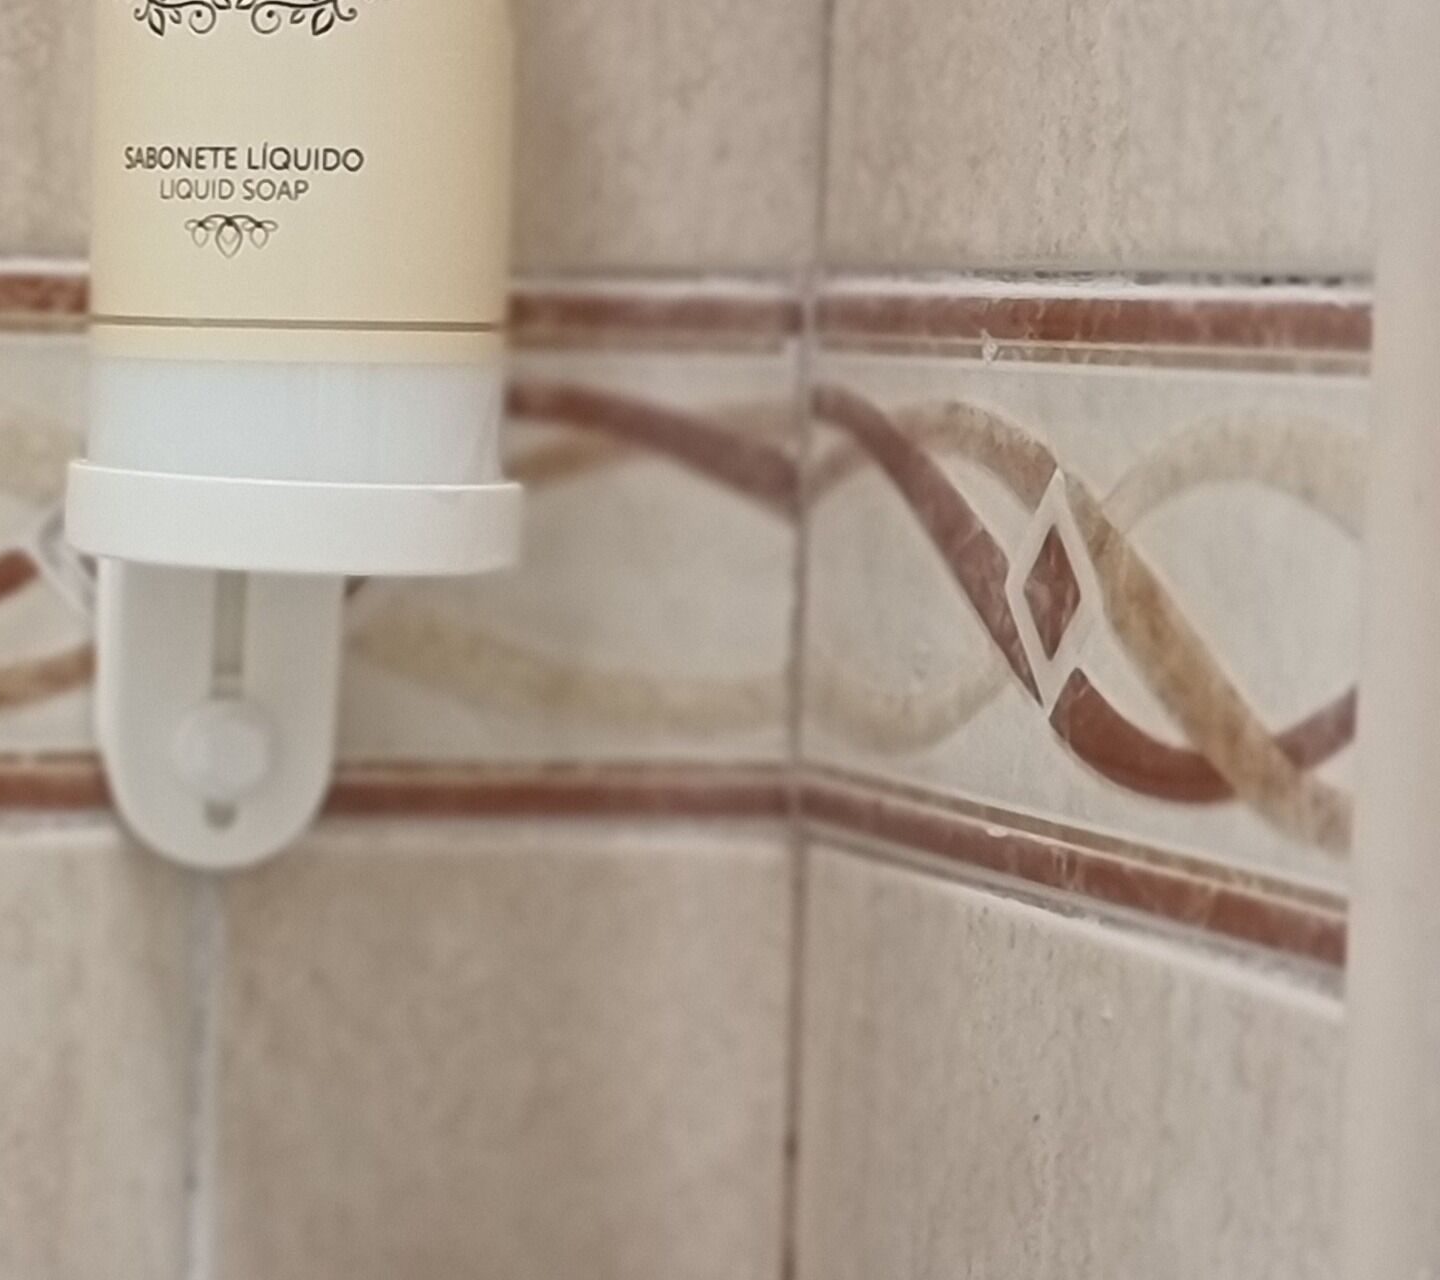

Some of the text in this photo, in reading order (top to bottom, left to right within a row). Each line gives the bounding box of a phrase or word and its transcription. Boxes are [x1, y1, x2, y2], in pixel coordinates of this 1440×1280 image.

[124, 141, 365, 172] SABONETE LÍQUIDO
[160, 178, 309, 201] LIQUID SOAP
